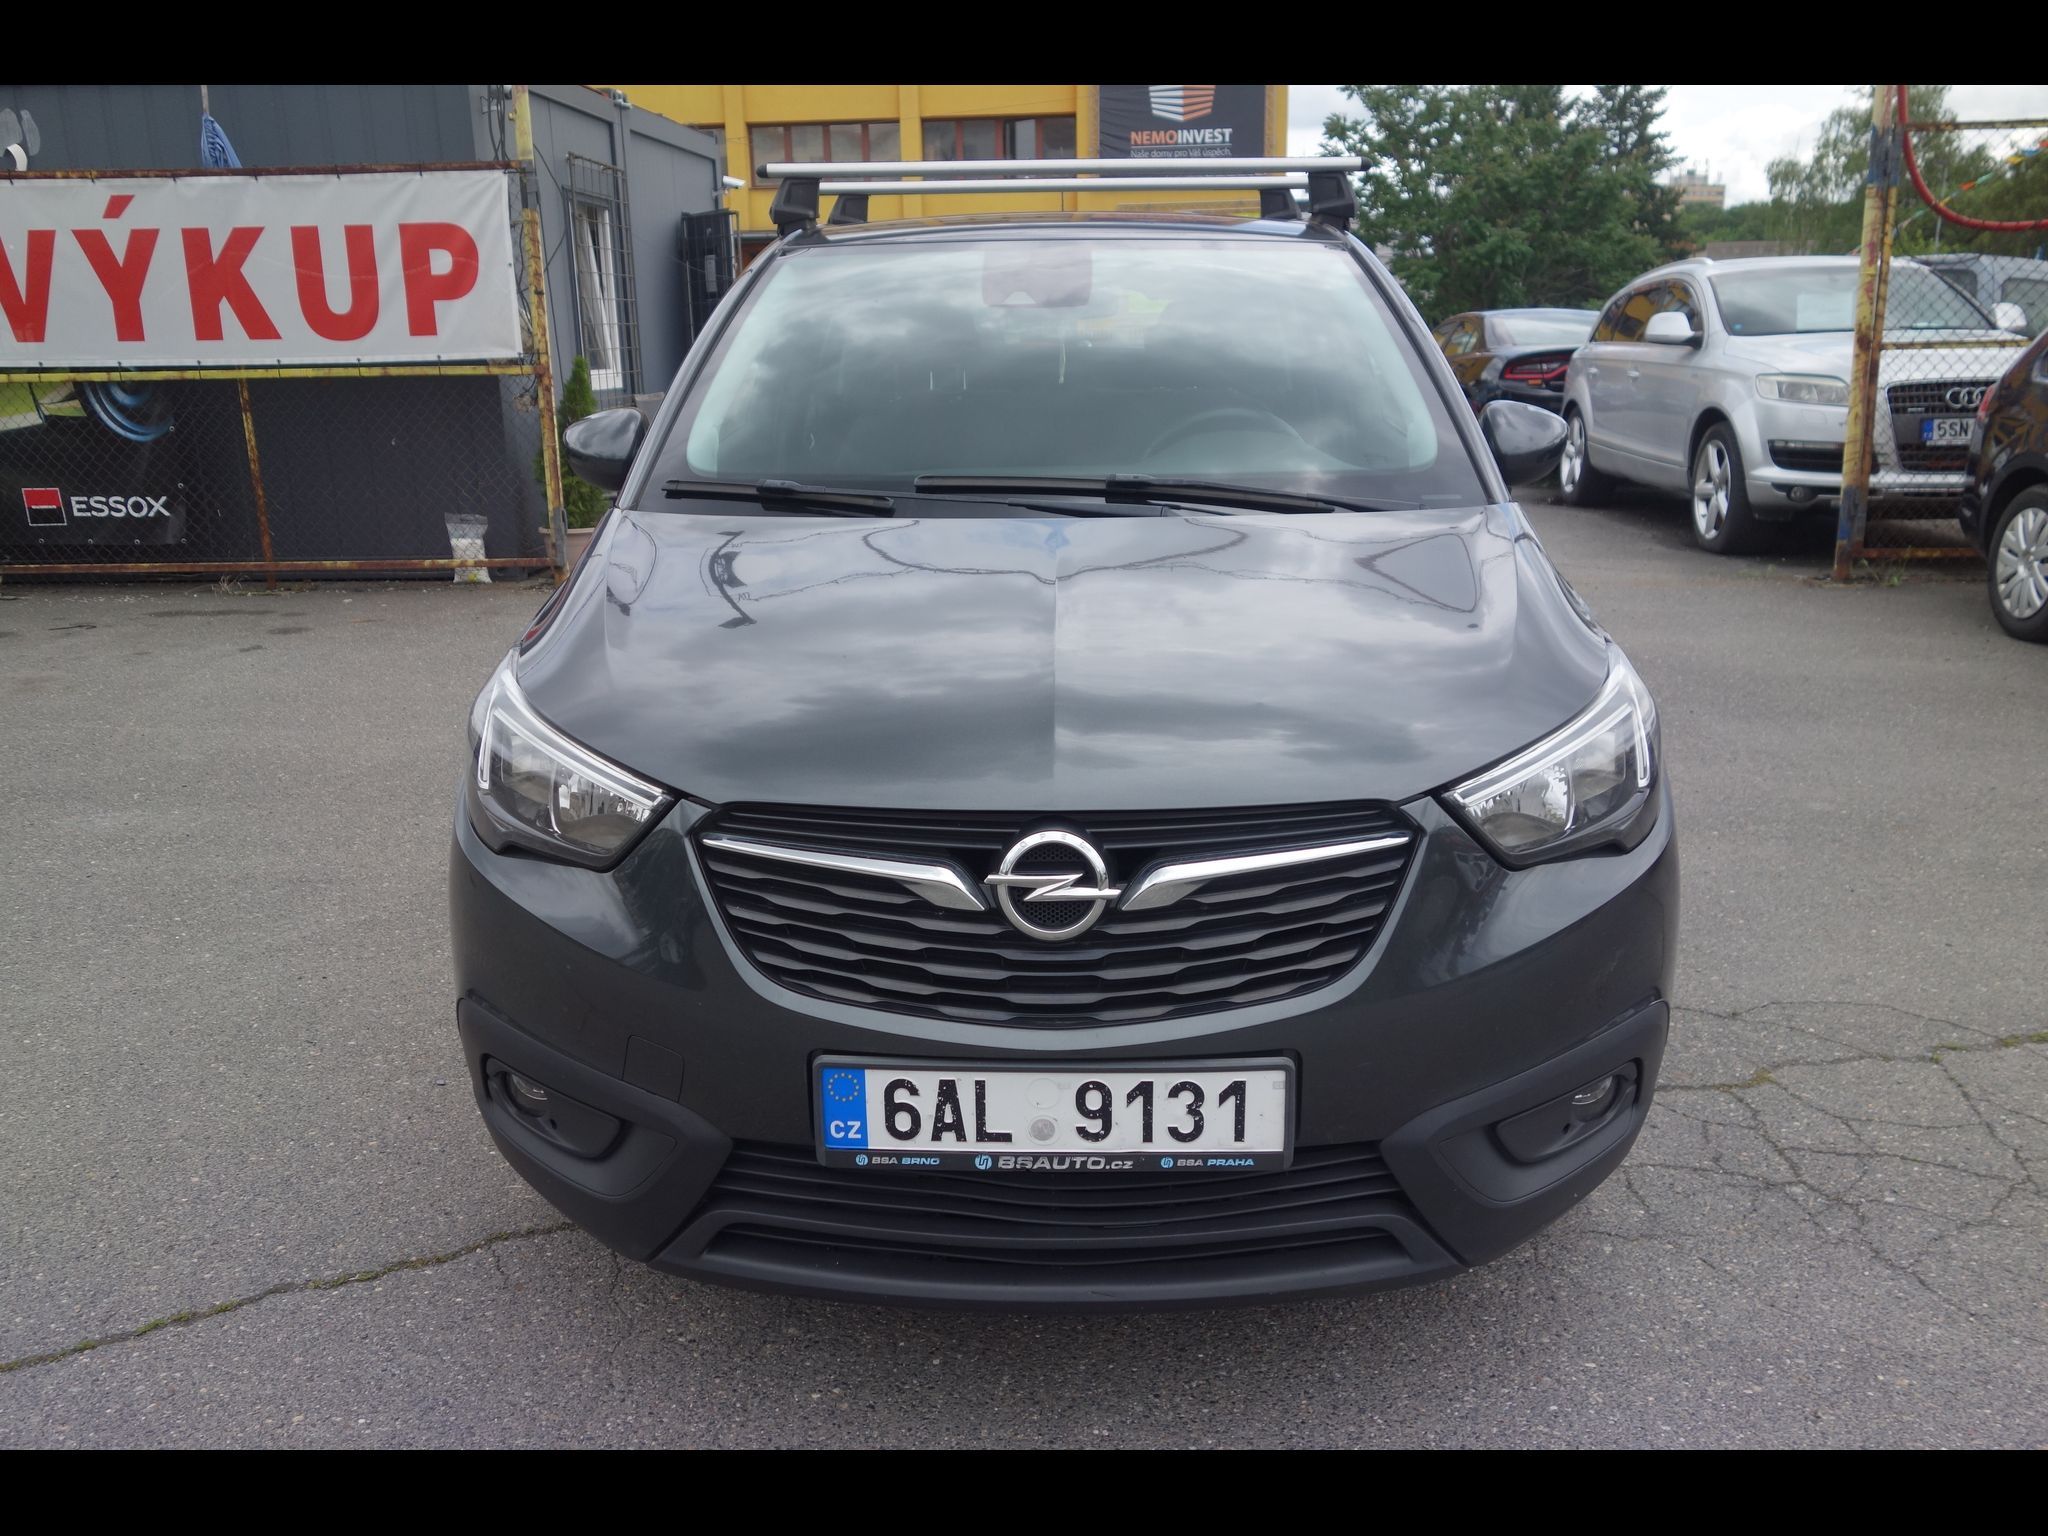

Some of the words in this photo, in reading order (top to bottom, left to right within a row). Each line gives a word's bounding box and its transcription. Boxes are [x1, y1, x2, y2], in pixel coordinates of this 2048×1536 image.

[1130, 128, 1233, 145] NEMOINVEST
[1130, 149, 1149, 158] Naše
[1150, 148, 1173, 158] domy
[1174, 149, 1188, 158] pro
[0, 194, 480, 343] VÝKUP
[70, 496, 171, 518] ESSOX
[884, 1078, 1013, 1143] 6AL
[1075, 1080, 1247, 1143] 9131
[830, 1120, 862, 1139] CZ
[871, 1156, 898, 1165] BSA
[901, 1157, 940, 1165] BRNO
[1177, 1158, 1204, 1167] BSA
[1207, 1158, 1255, 1167] PRAHA
